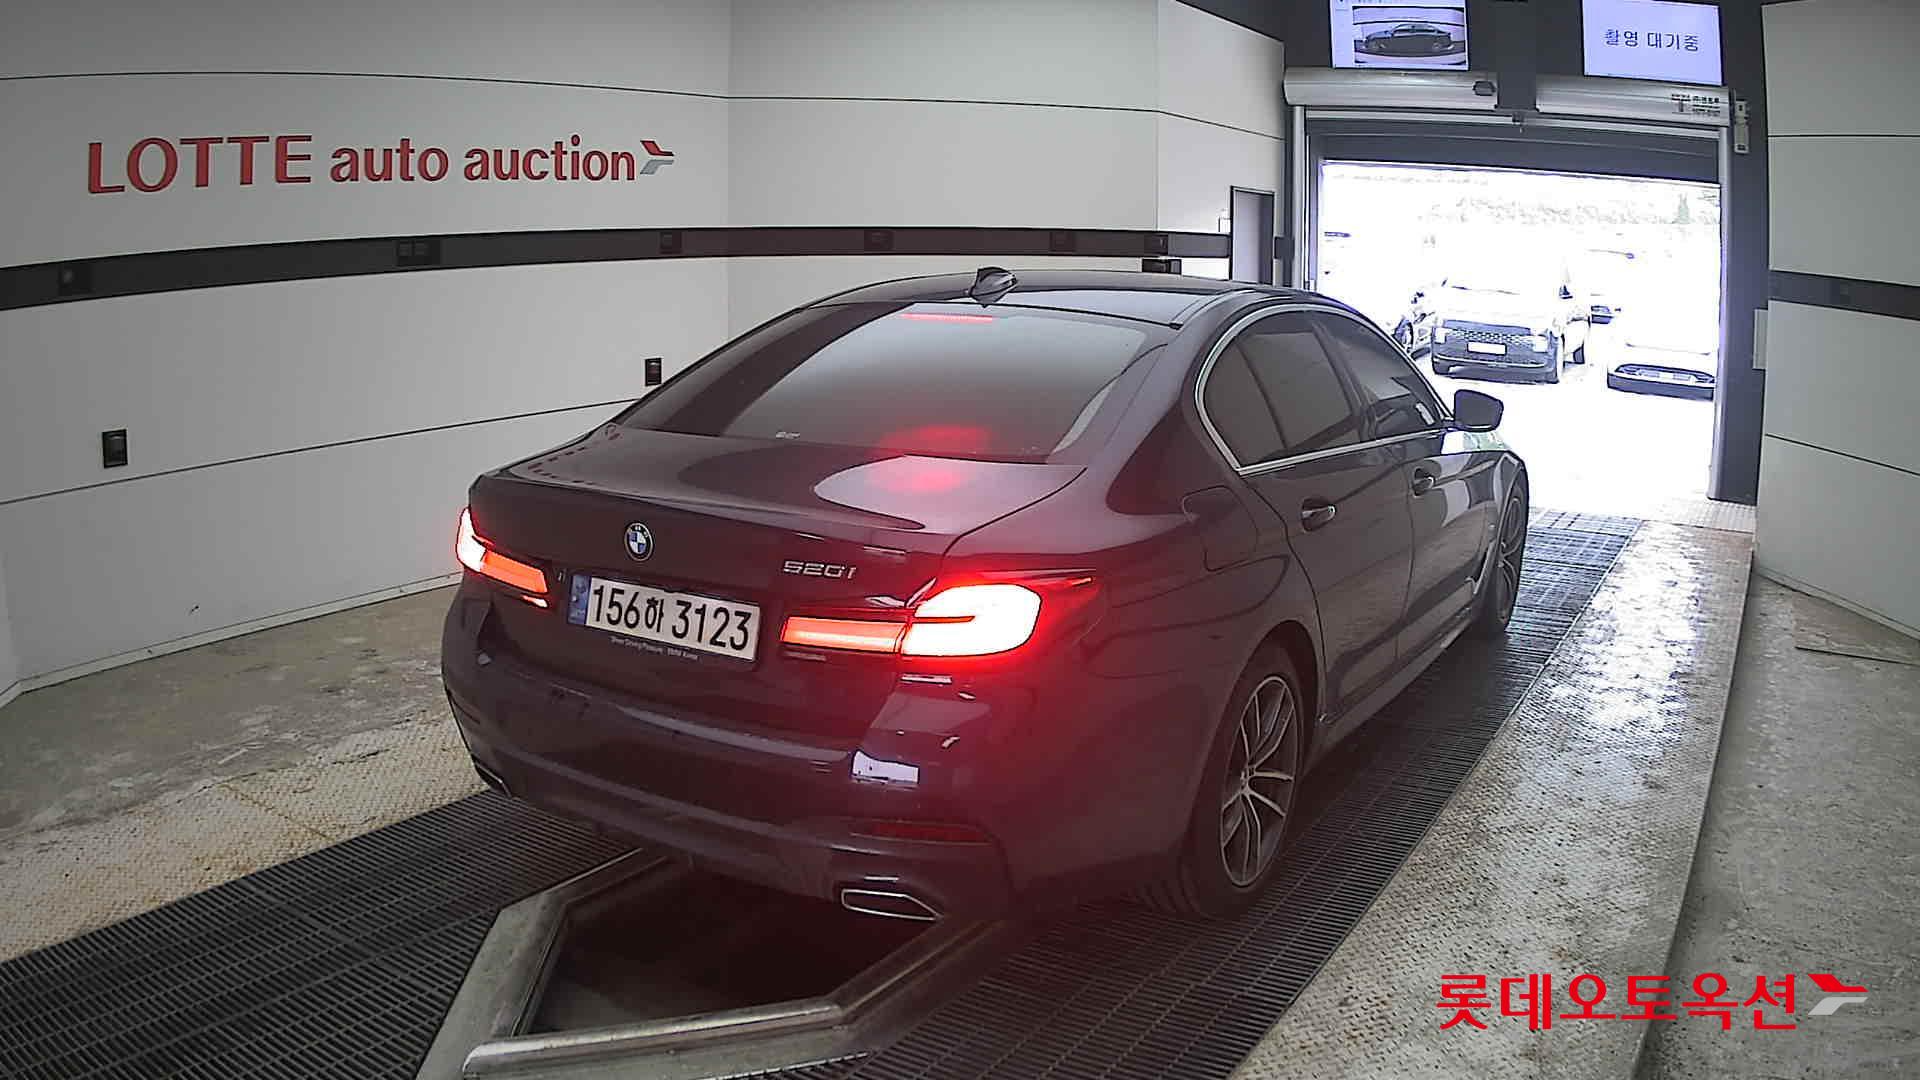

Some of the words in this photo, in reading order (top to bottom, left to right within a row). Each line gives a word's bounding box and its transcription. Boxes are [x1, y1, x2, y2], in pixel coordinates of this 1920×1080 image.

[1605, 28, 1638, 47] 촬영
[1646, 32, 1699, 52] 대기중
[87, 135, 312, 194] LOTTE
[330, 138, 449, 182] auto
[463, 134, 636, 181] auction
[783, 560, 857, 579] 520i
[593, 585, 664, 633] 156하
[671, 600, 752, 651] 3123
